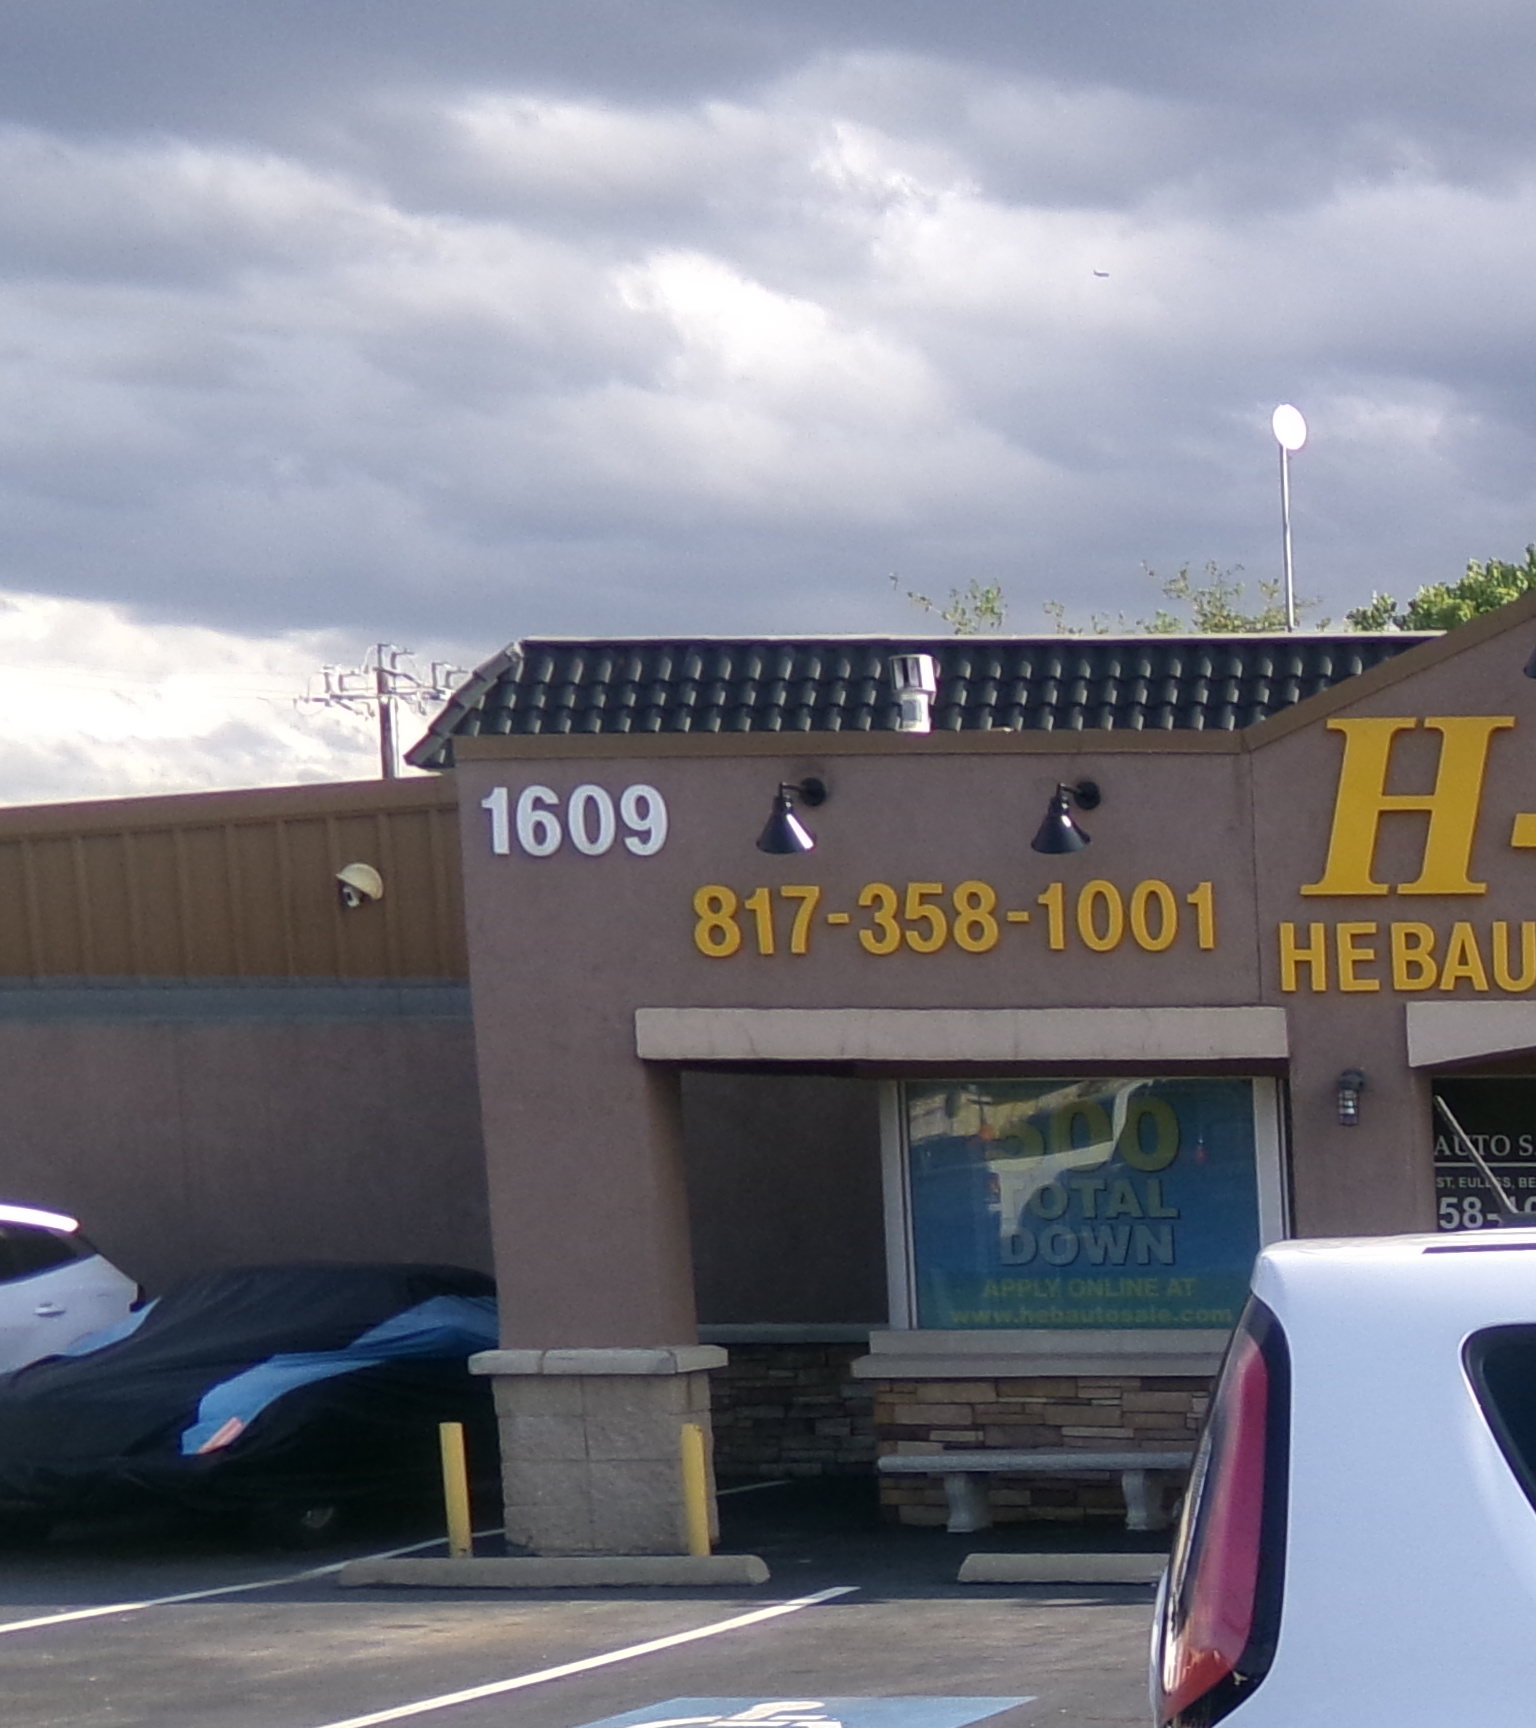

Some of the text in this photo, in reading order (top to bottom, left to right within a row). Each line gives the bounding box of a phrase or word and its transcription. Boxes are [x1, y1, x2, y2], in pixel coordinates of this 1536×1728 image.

[481, 784, 669, 857] 1609
[693, 879, 1217, 958] 817-358-1001
[1434, 1134, 1511, 1157] AUTO
[1000, 1179, 1180, 1220] TOTAL
[1001, 1225, 1176, 1266] DOWN
[984, 1278, 1197, 1298] APPLY ONLINE AT
